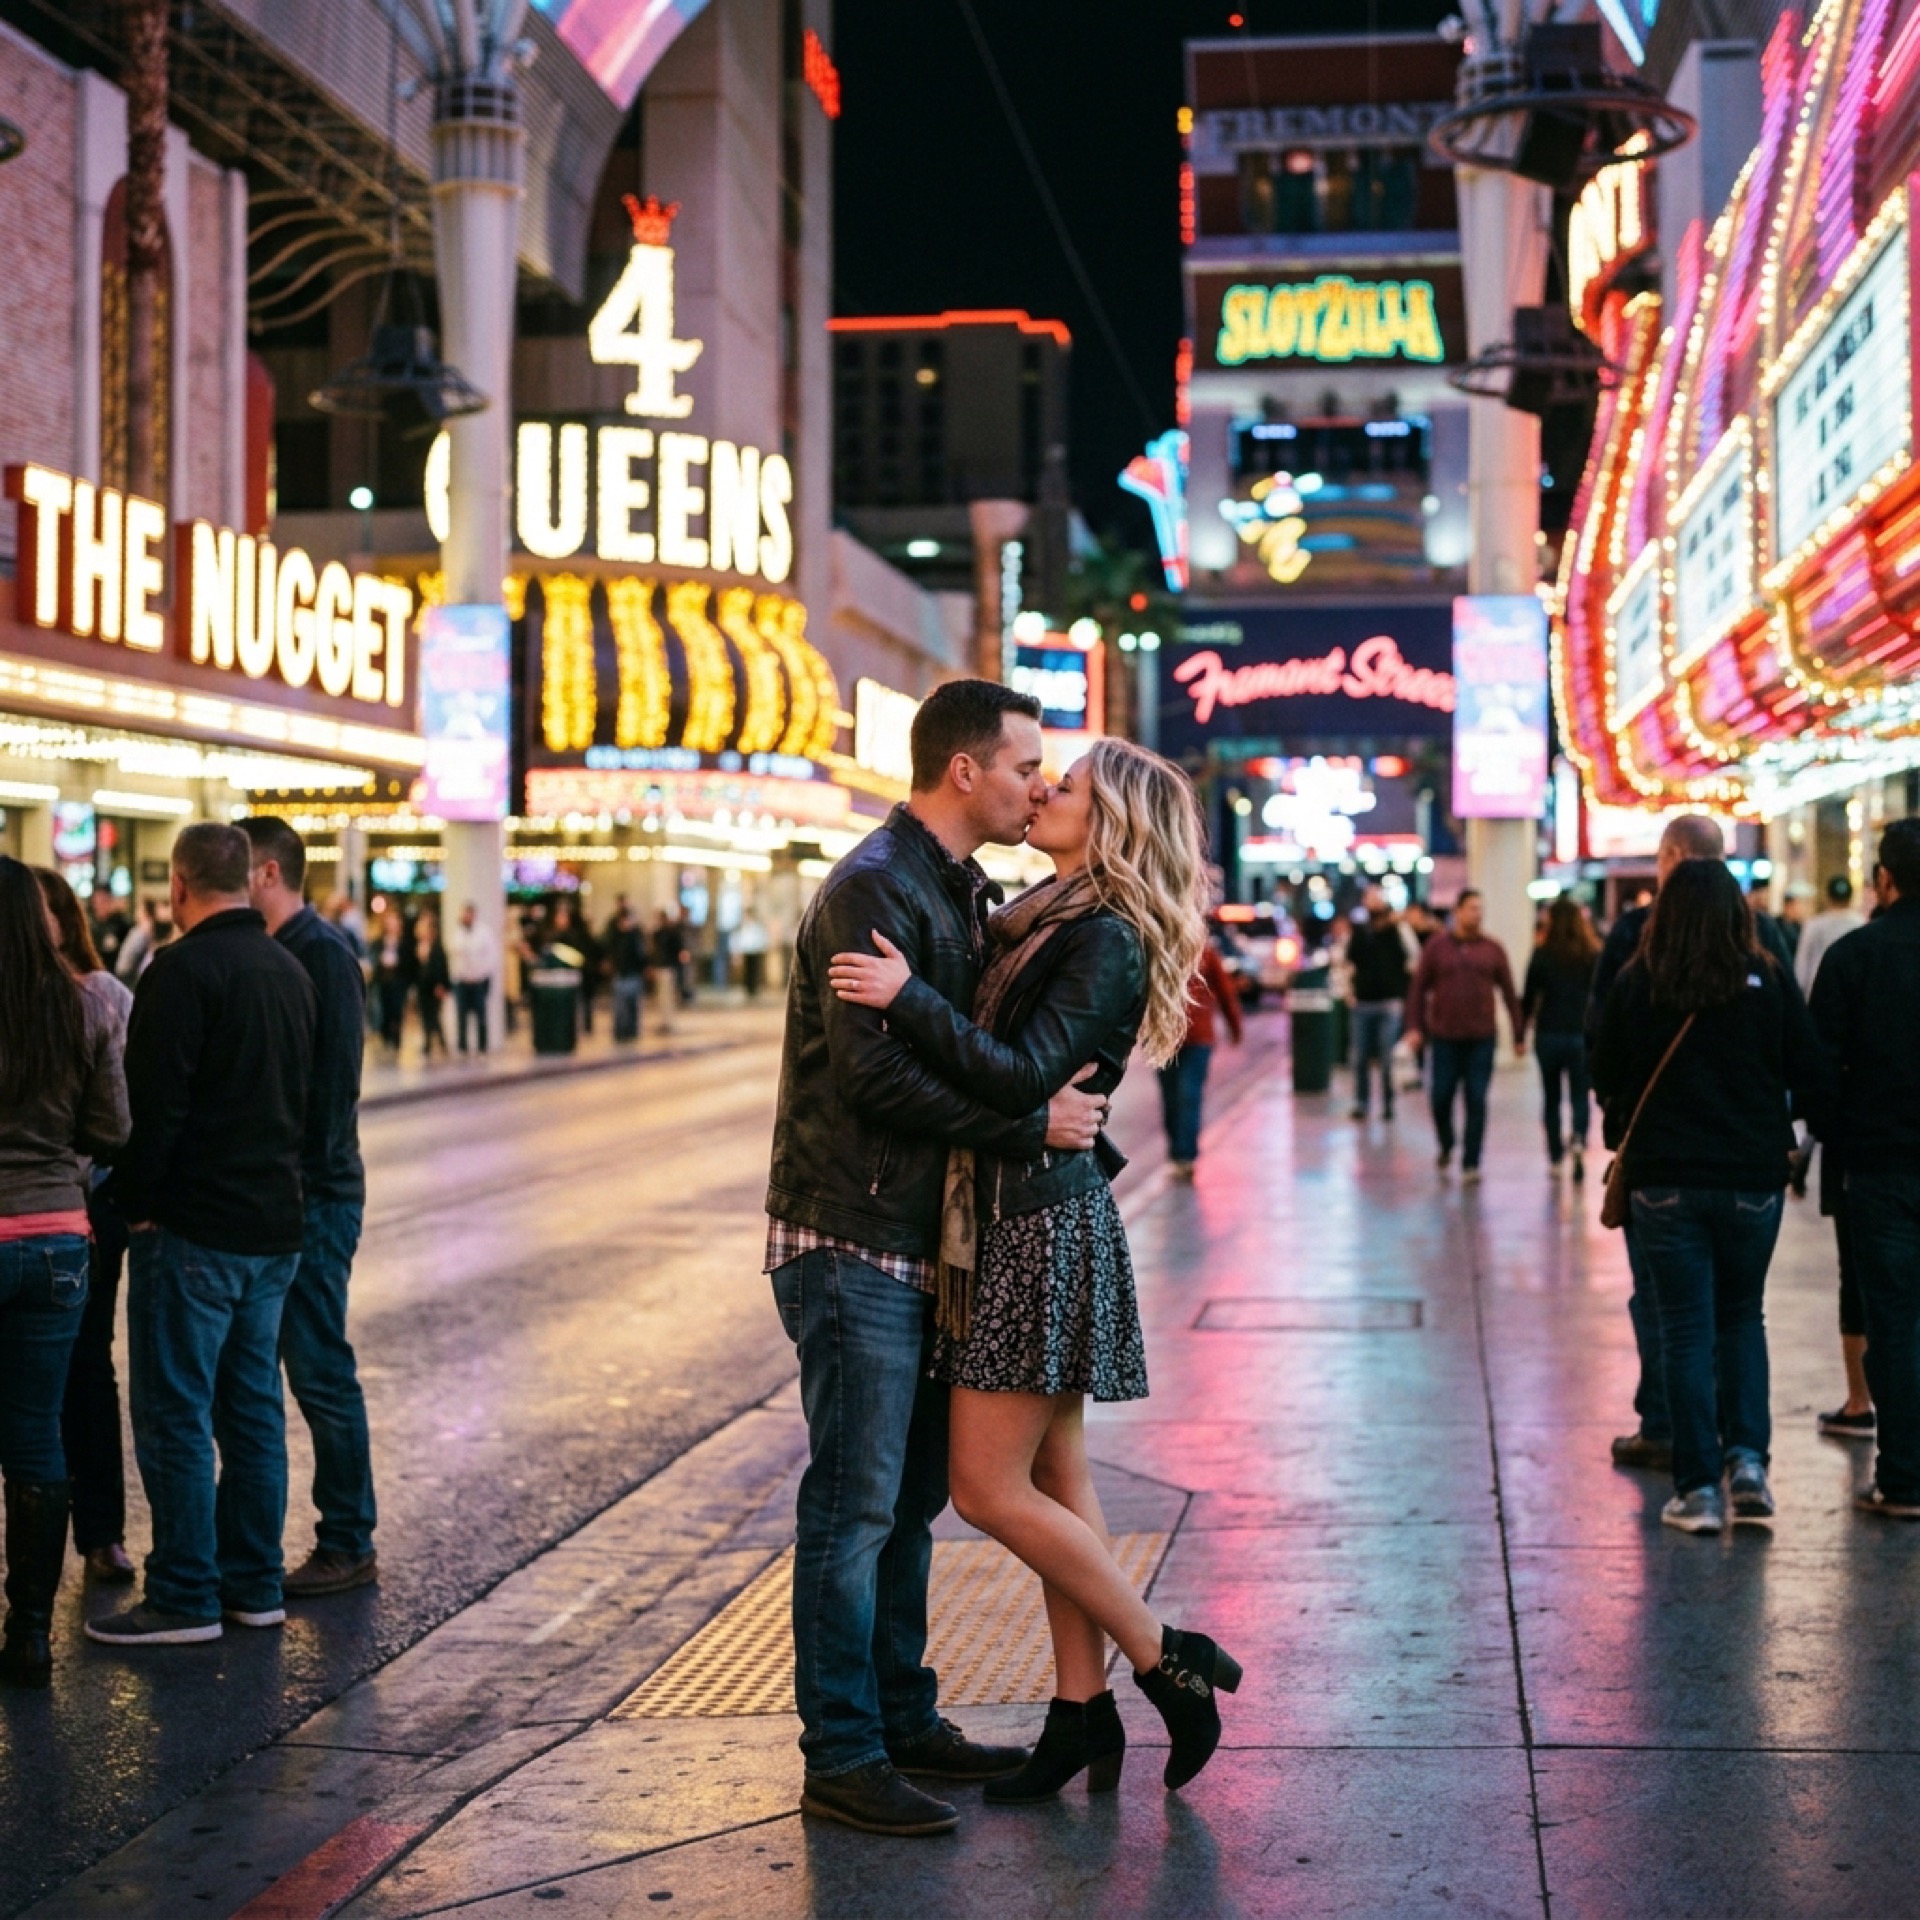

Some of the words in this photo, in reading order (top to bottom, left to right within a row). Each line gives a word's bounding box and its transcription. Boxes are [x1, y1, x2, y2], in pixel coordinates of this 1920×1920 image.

[588, 244, 703, 418] 4
[23, 461, 165, 652] THE
[191, 517, 413, 707] NUGGET
[1173, 648, 1346, 725] Fremont
